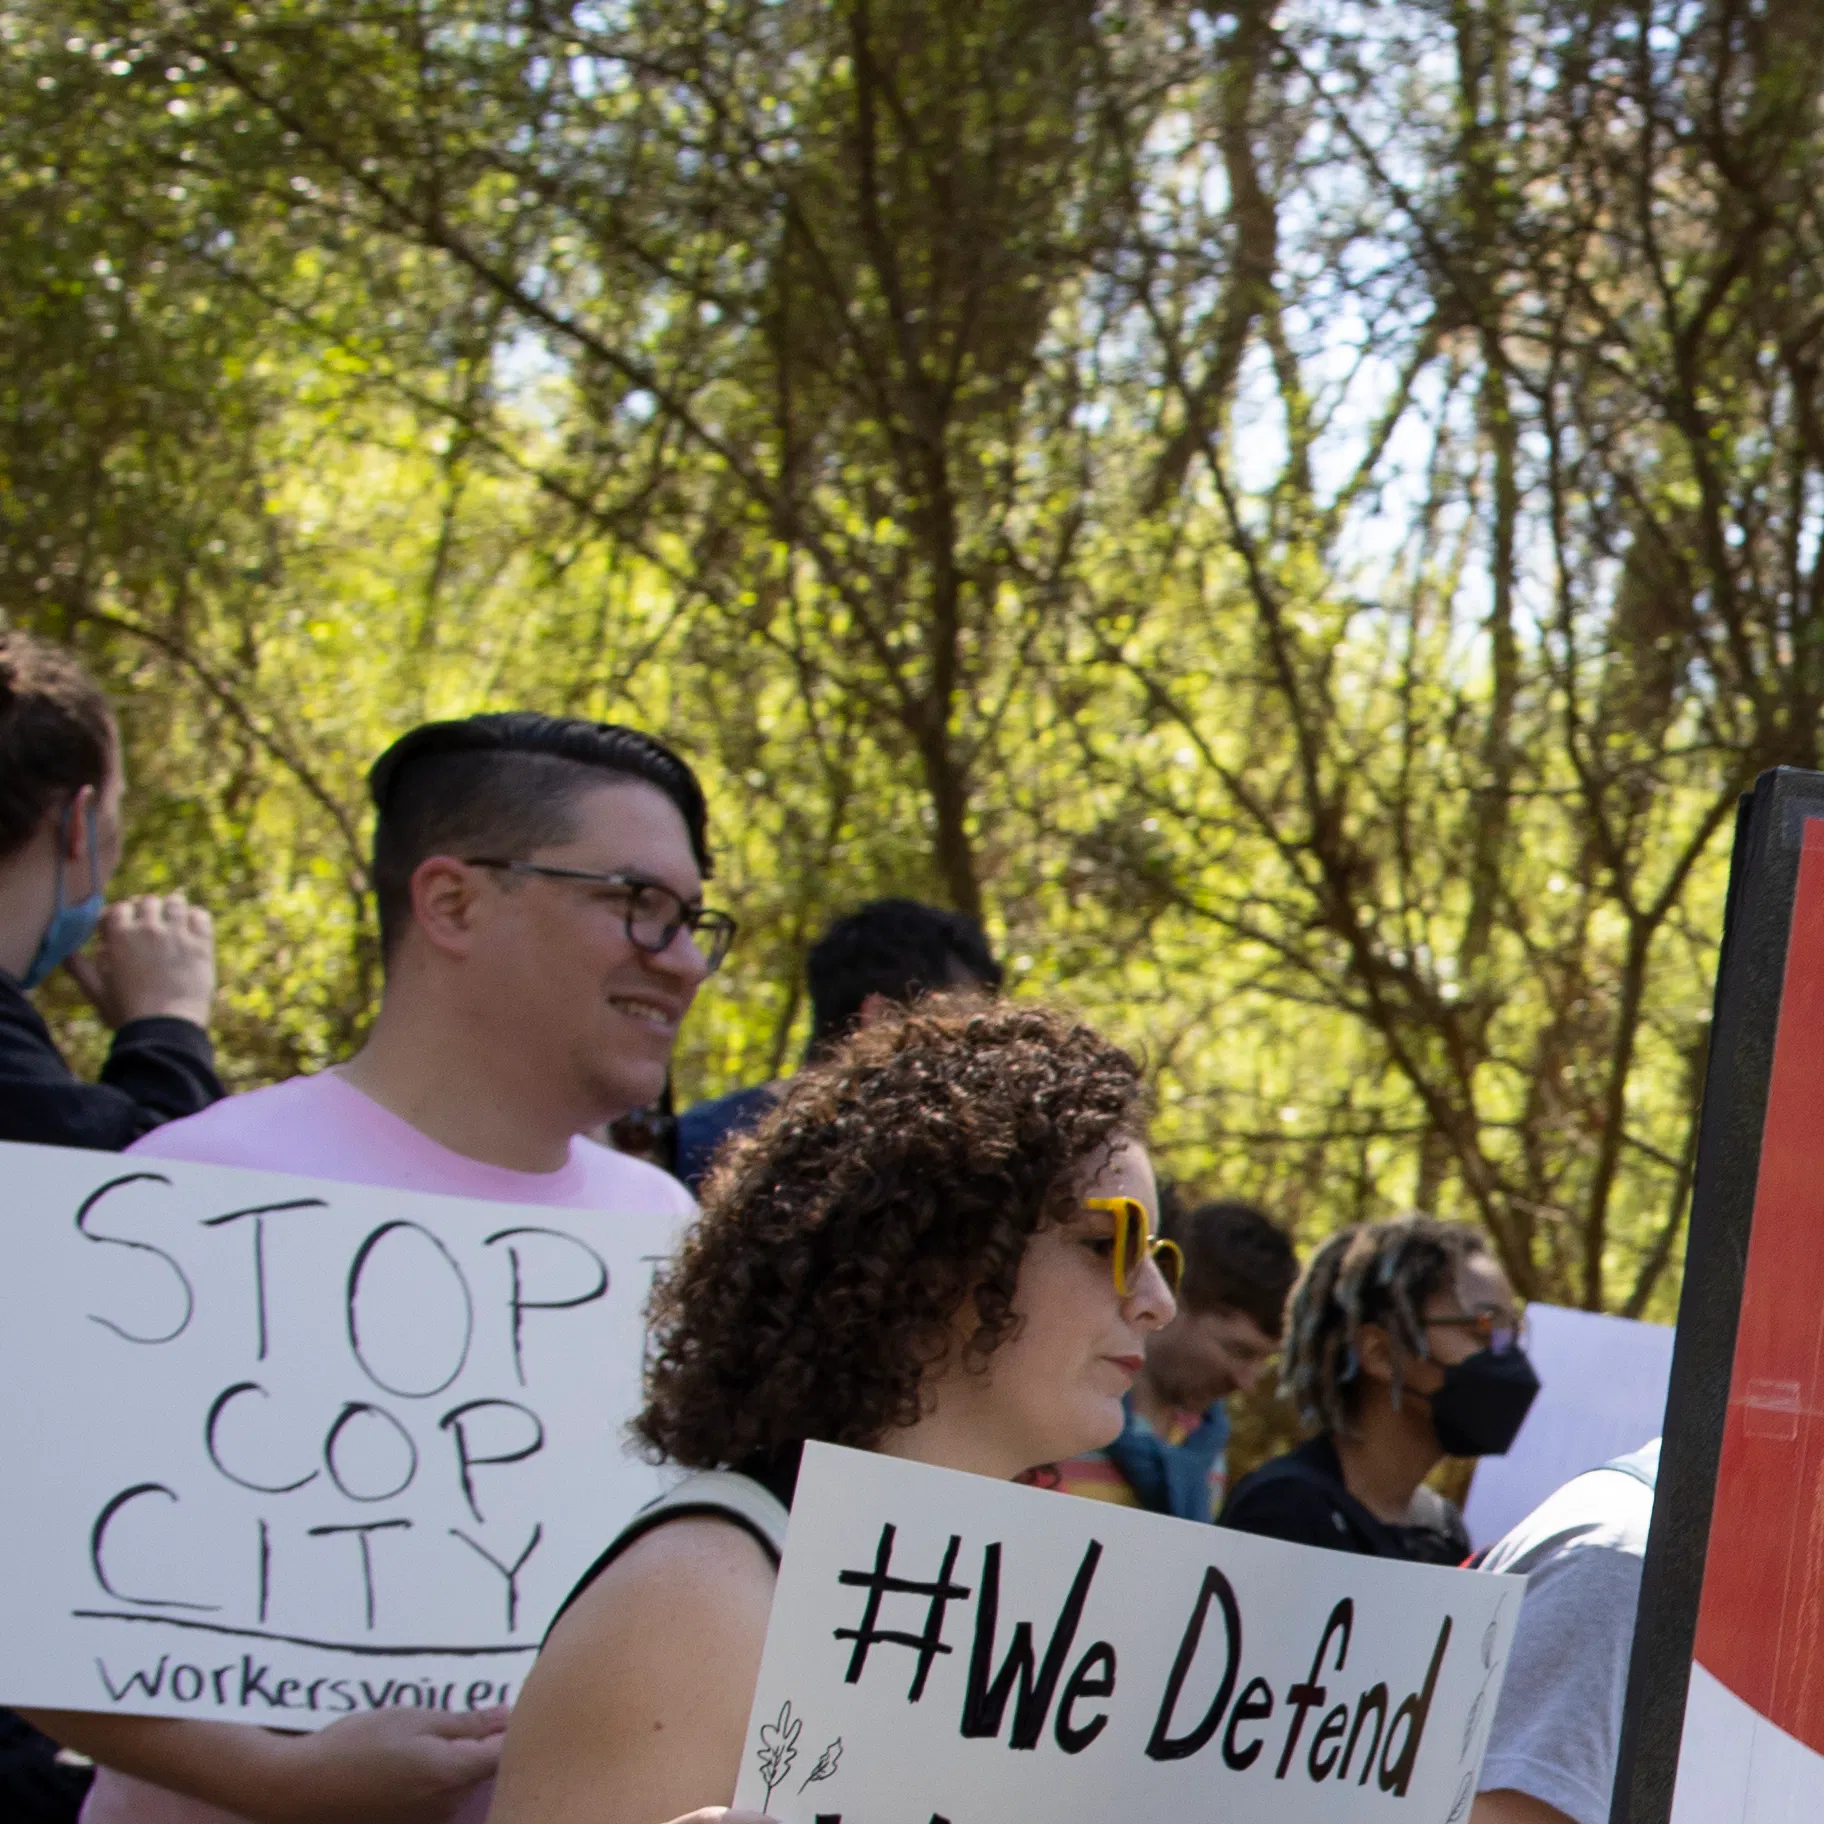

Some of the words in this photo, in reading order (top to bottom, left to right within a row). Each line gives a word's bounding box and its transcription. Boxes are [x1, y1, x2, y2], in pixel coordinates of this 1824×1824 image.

[76, 1172, 611, 1398] STOP
[205, 1381, 544, 1523] COP
[91, 1483, 543, 1634] CITY
[833, 1522, 1117, 1754] #We
[1145, 1565, 1454, 1798] Defend
